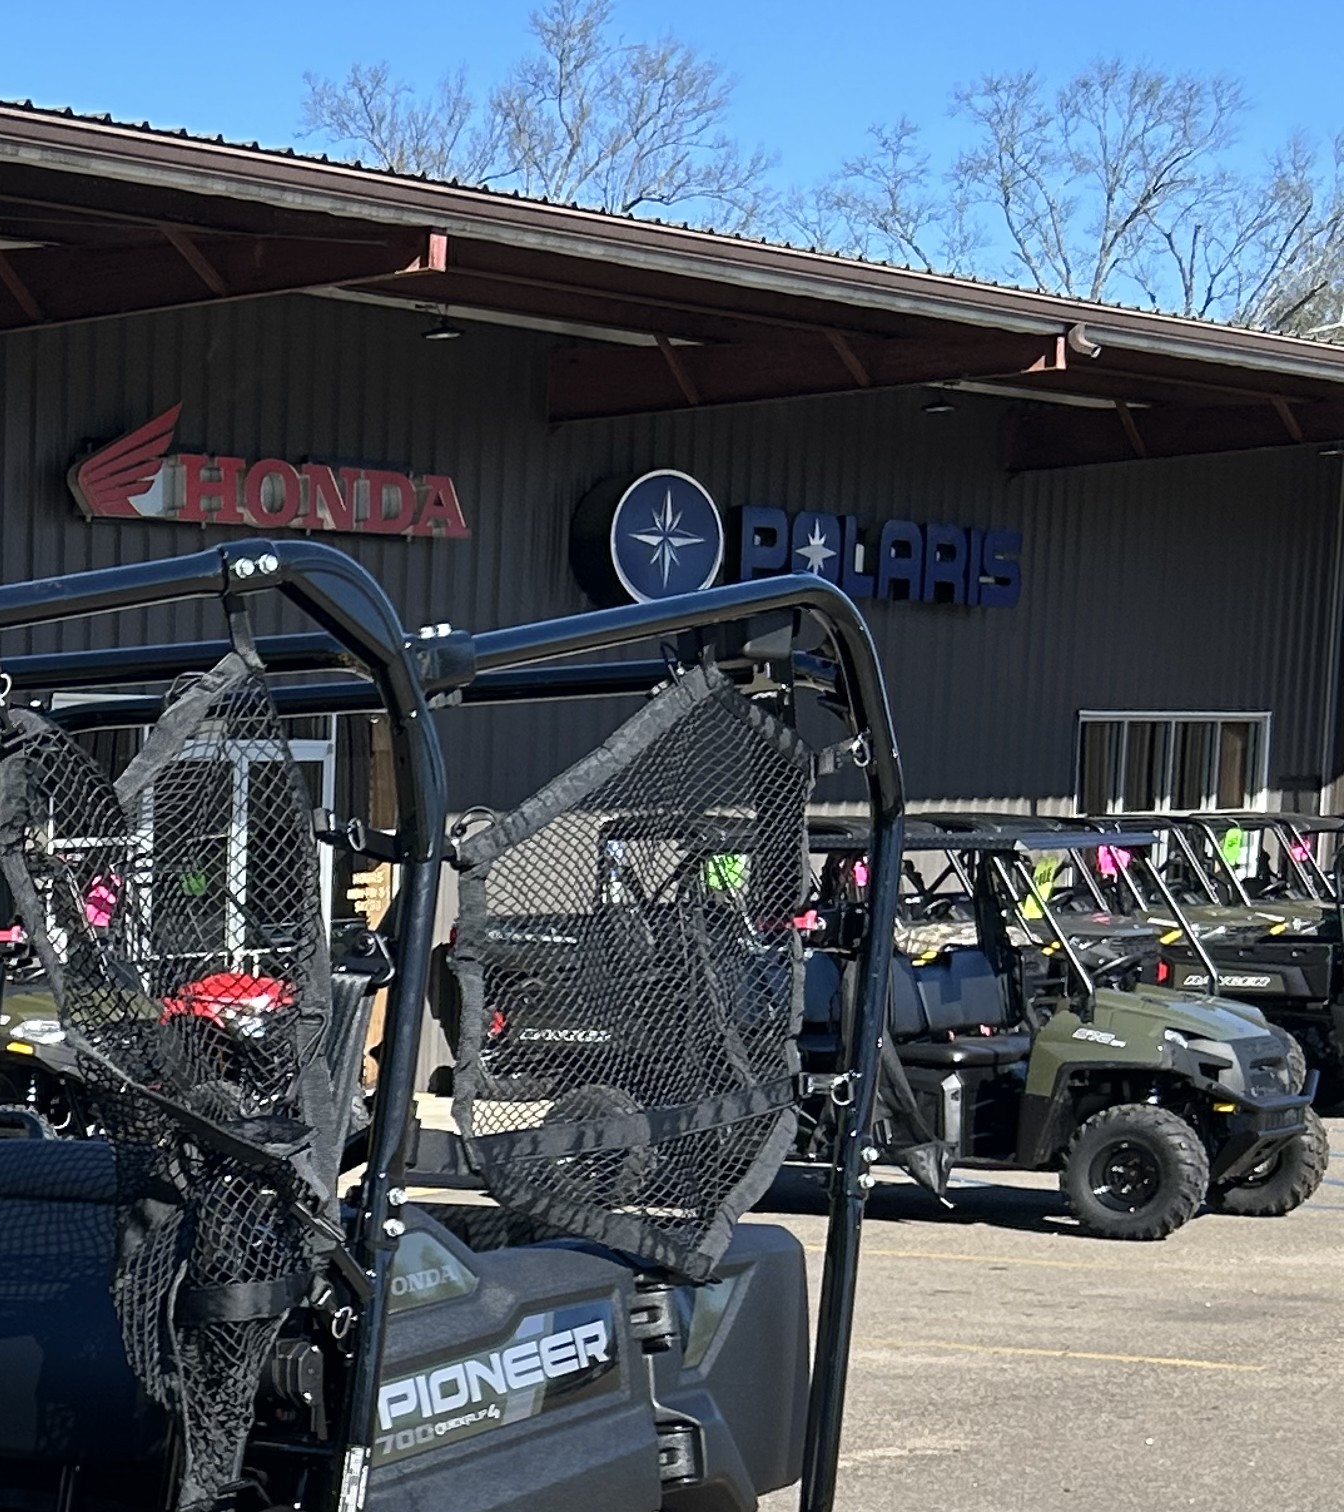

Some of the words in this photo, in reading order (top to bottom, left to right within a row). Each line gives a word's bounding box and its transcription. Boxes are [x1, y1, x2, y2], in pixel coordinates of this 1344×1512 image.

[178, 453, 471, 539] HONDA
[739, 504, 1023, 609] POLARIS
[390, 1264, 459, 1296] ONDA
[377, 1319, 610, 1430] PIONEER
[374, 1423, 434, 1456] 700
